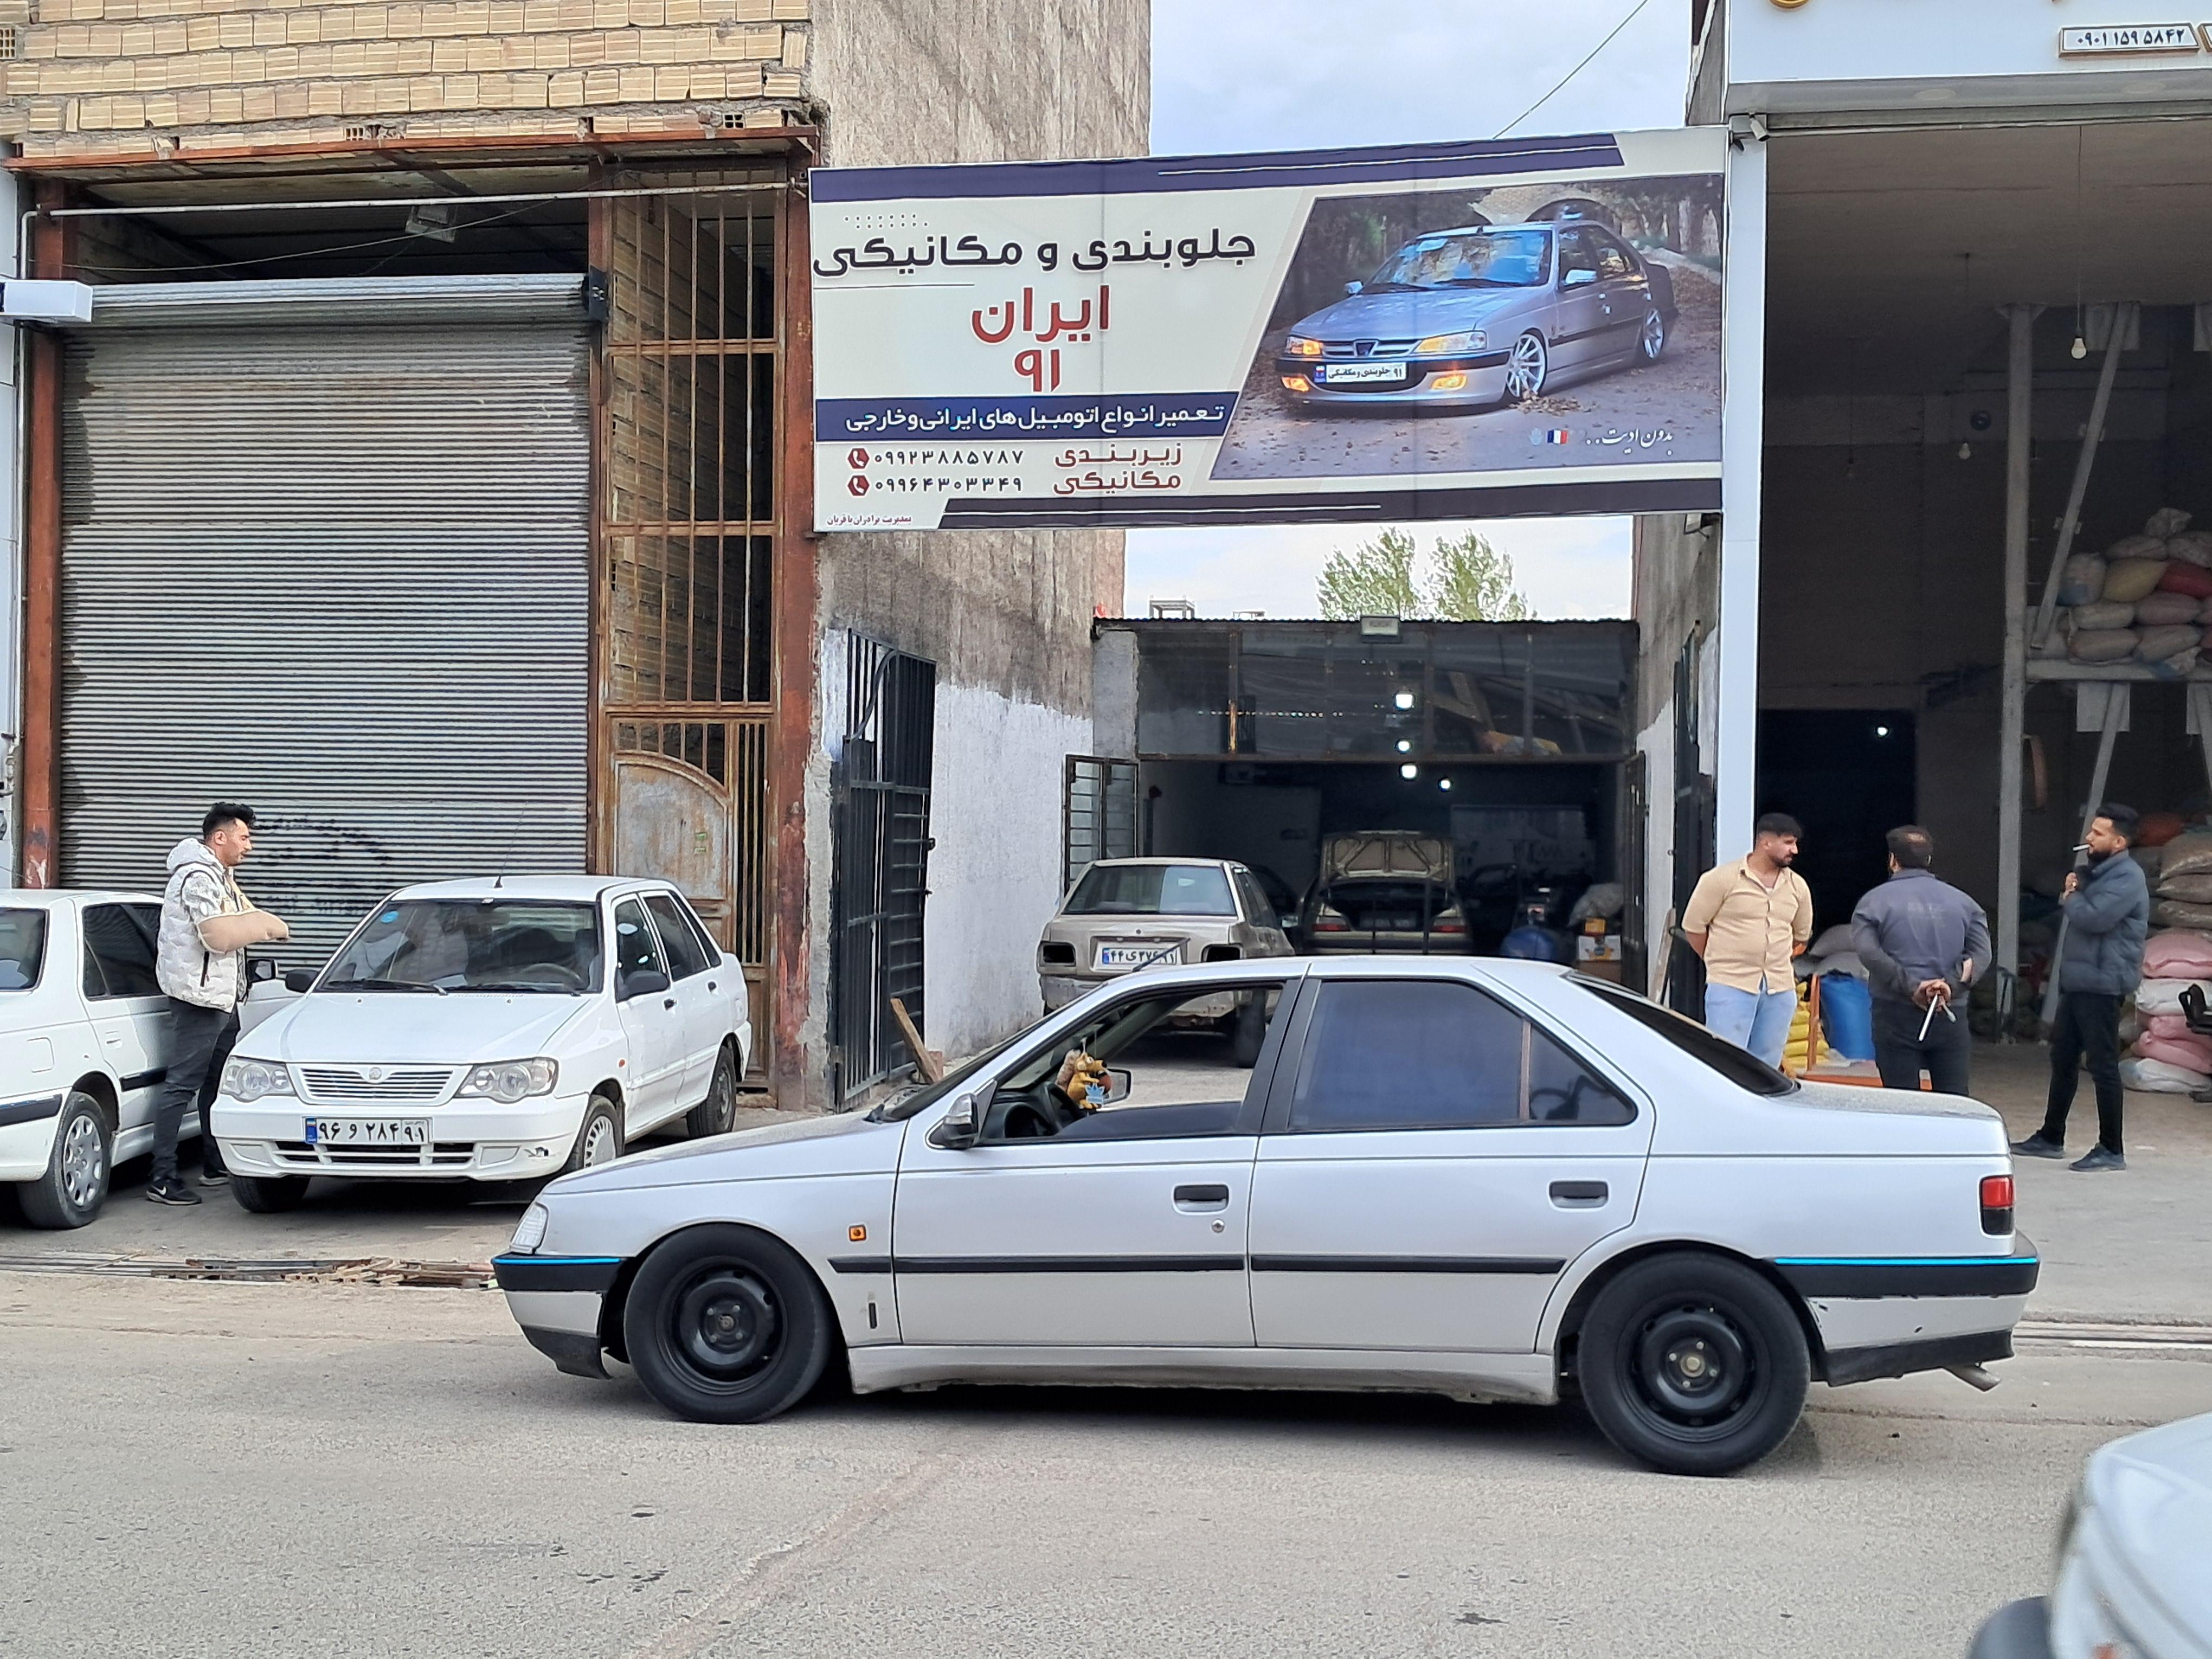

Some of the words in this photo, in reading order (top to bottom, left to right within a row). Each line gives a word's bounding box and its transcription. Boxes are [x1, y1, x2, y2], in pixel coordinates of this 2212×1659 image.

[2113, 30, 2138, 46] ۱۵۹
[813, 235, 1023, 277] مکانیکی
[1037, 241, 1058, 271] و
[1072, 228, 1256, 271] جلوبندی
[972, 285, 1109, 343] ایران
[1014, 349, 1060, 392] ۹۱
[846, 408, 907, 431] خارجی
[919, 408, 976, 430] ایرانی
[1101, 404, 1154, 433] انواع
[1155, 406, 1225, 427] تعمیر
[1054, 442, 1181, 467] زیربندی
[1639, 429, 1673, 456] بدون
[874, 451, 1024, 465] ۰۹۹۲۳۸۸۵۷۸۷
[875, 478, 1021, 492] ۰۹۹۶۴۳۰۳۳۴۹
[1053, 471, 1181, 494] مکانیکی
